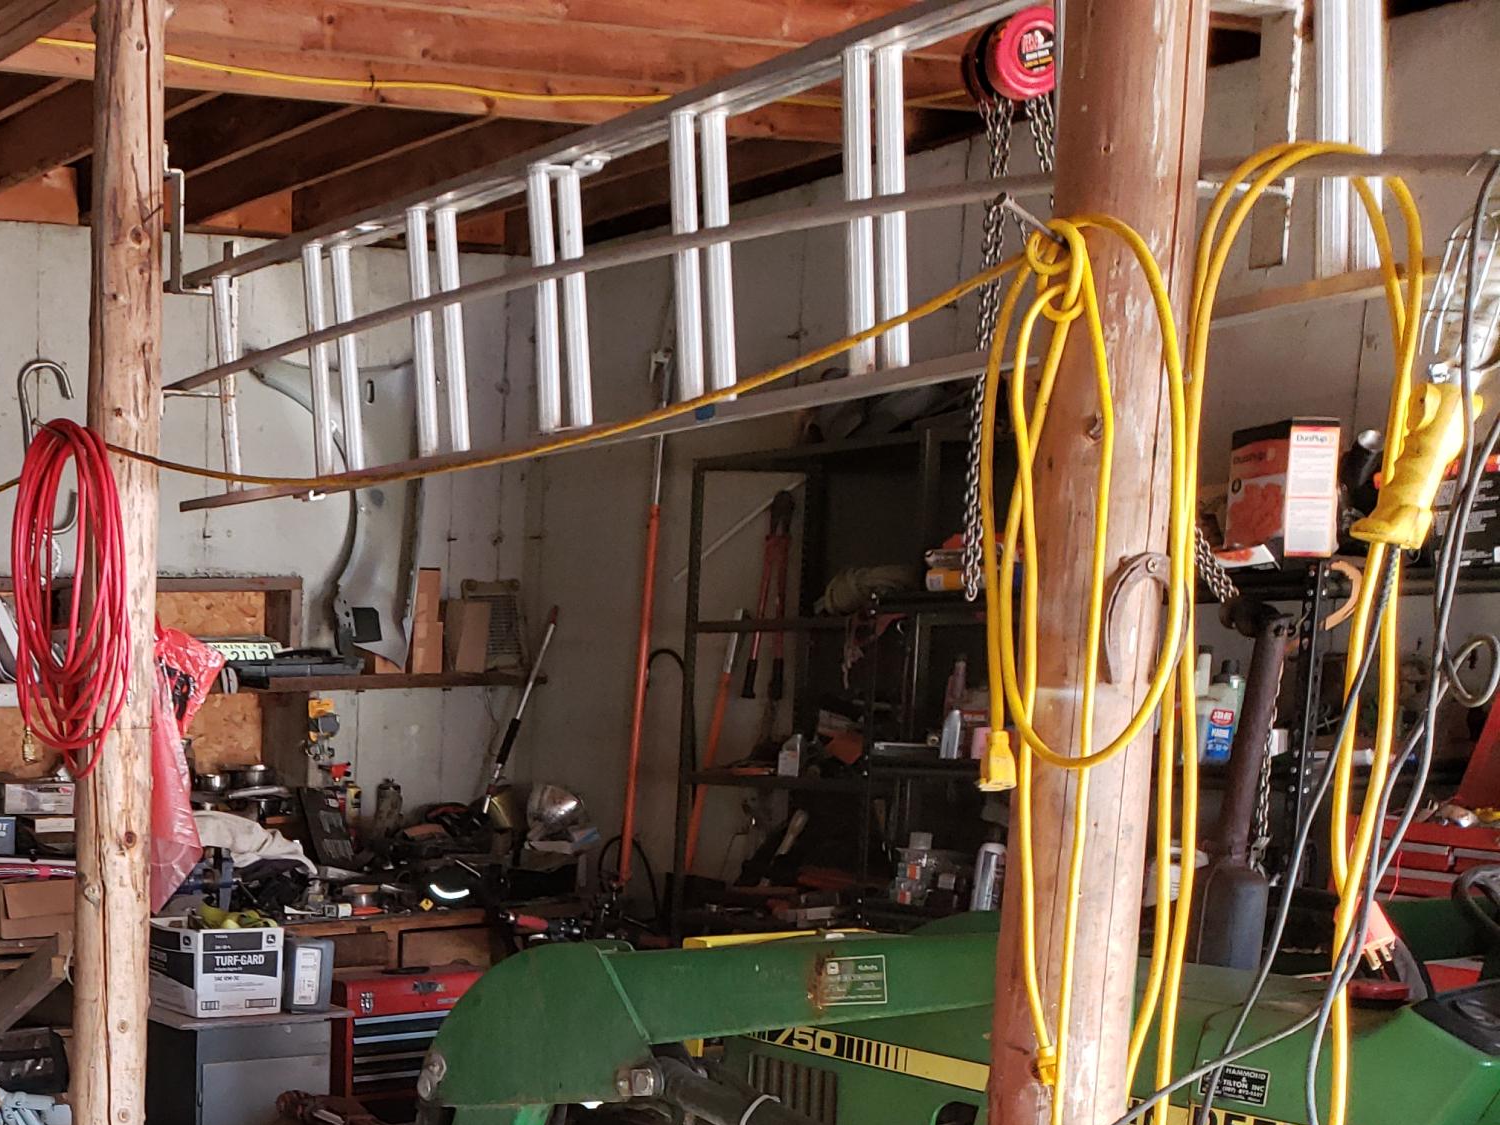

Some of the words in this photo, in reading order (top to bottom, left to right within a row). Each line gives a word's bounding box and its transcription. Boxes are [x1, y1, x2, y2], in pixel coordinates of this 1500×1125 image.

[214, 954, 265, 967] TURF-GARD
[1225, 1067, 1267, 1080] HAMMOND
[1223, 1079, 1249, 1089] TILTON
[1251, 1084, 1265, 1092] INC
